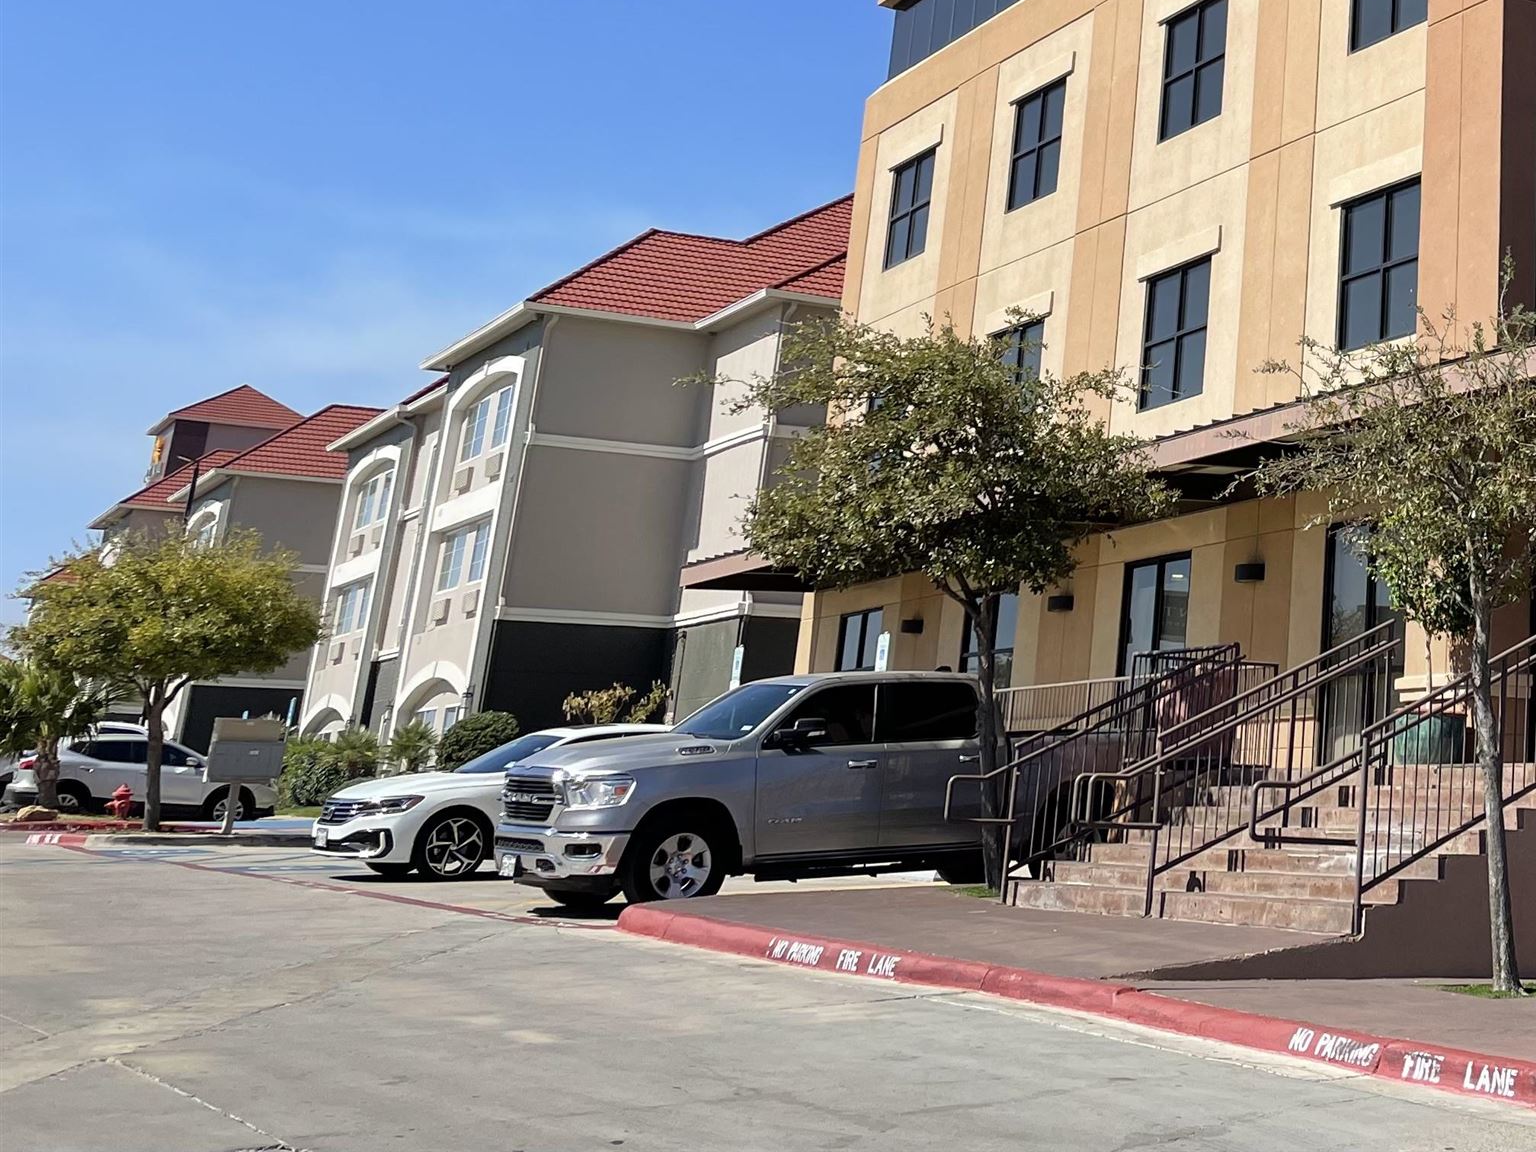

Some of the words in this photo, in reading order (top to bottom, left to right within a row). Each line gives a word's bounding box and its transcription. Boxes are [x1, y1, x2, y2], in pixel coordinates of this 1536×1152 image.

[771, 939, 789, 958] NO
[786, 941, 824, 966] PARKING
[836, 949, 863, 972] FIRE
[867, 953, 902, 977] LANE
[1288, 1027, 1315, 1052] NO
[1314, 1032, 1380, 1067] PARKING
[1402, 1050, 1446, 1084] FIRE
[1463, 1060, 1519, 1097] LANE
